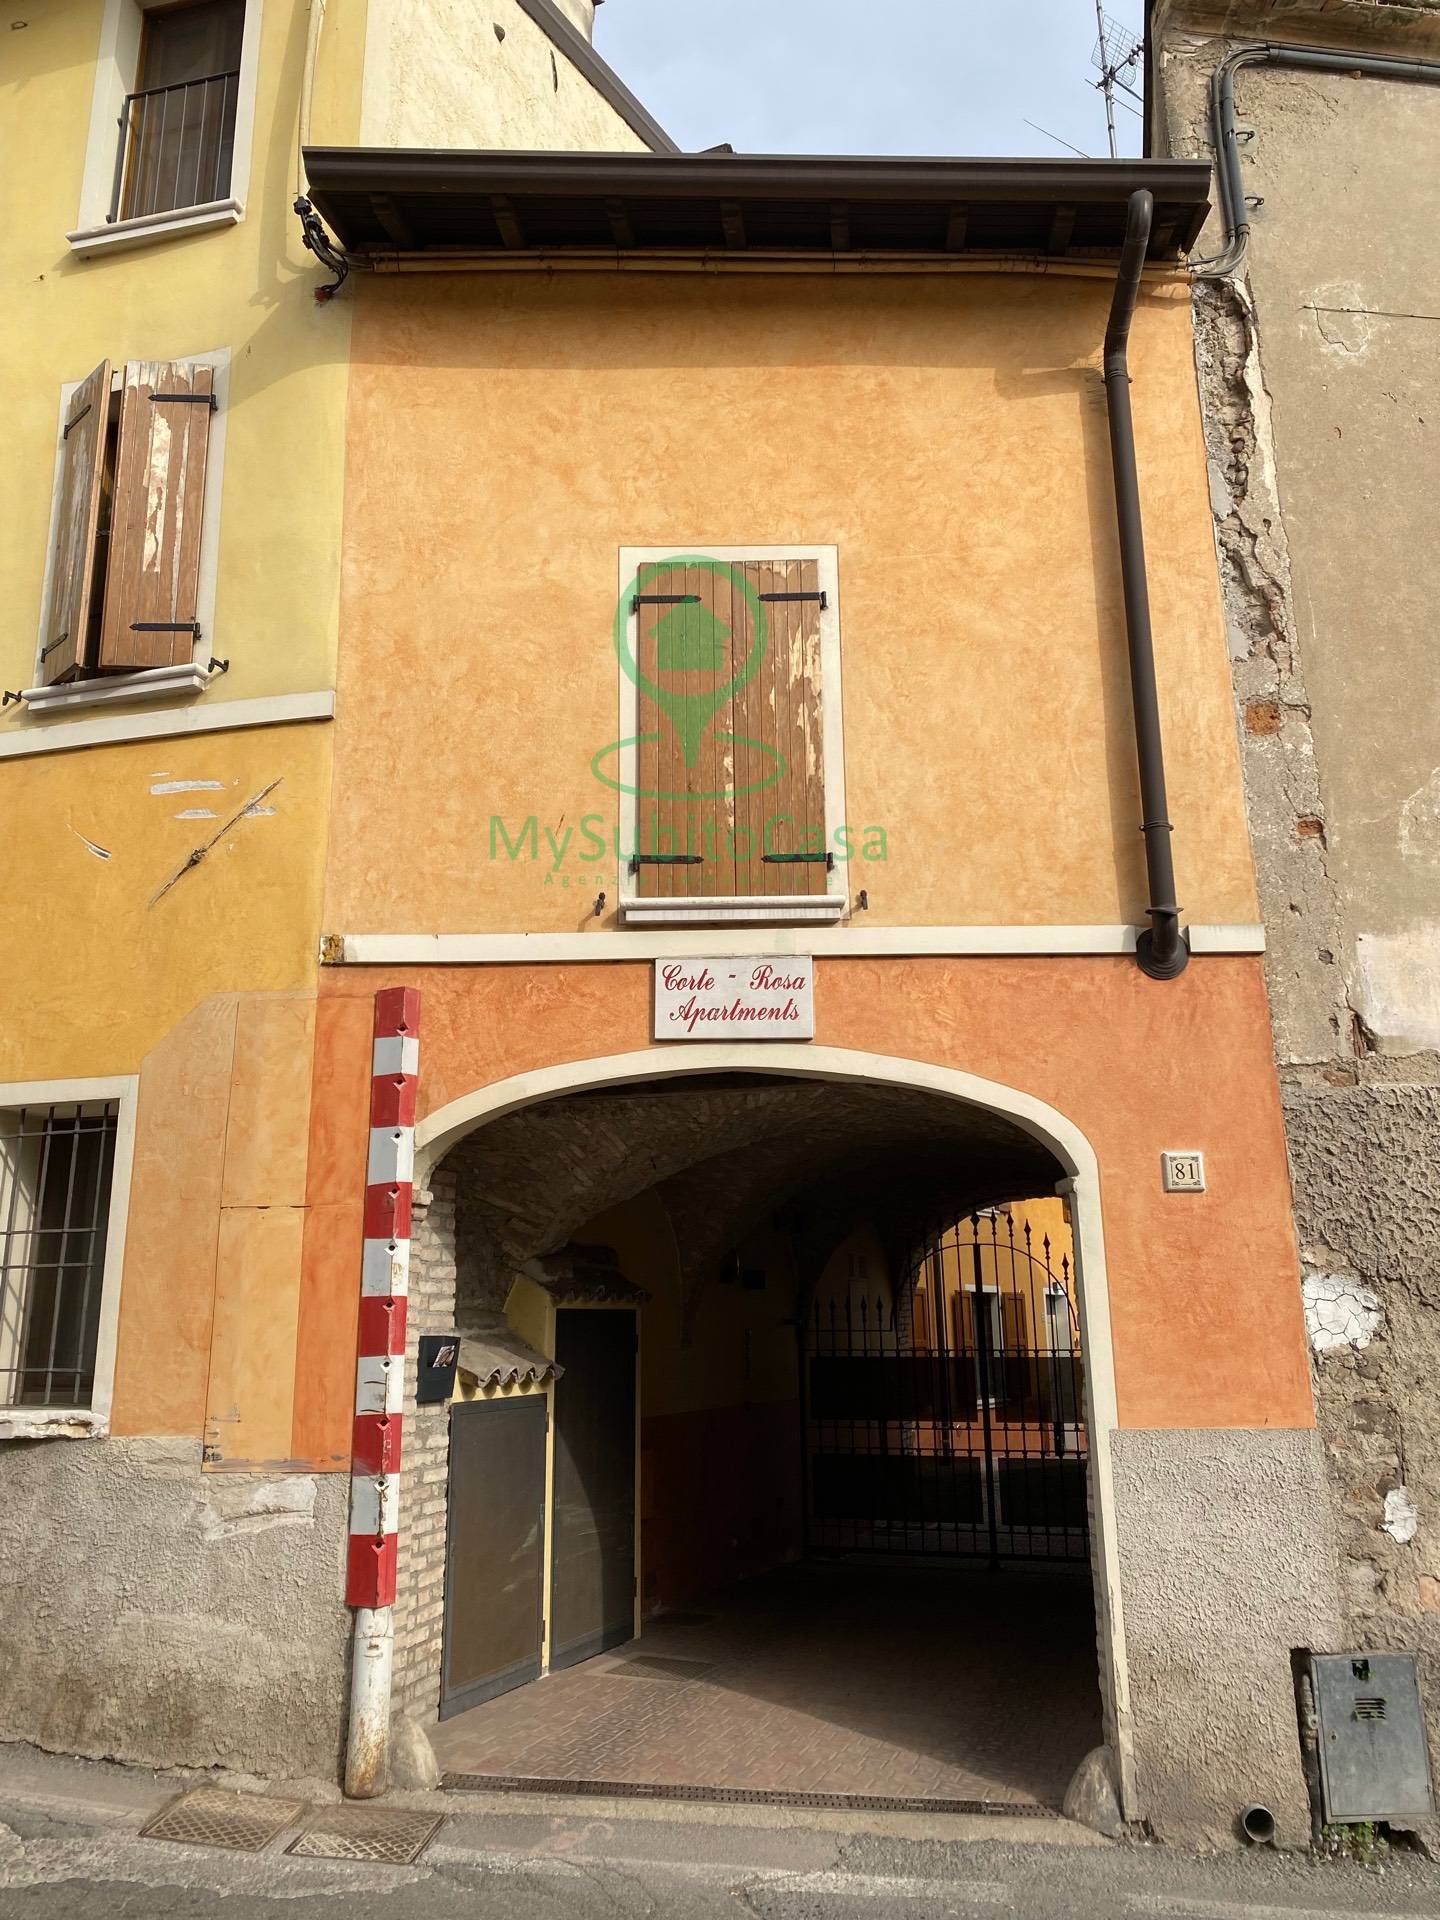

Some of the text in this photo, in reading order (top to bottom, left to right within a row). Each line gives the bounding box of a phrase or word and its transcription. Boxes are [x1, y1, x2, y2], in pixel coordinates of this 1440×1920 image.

[662, 964, 715, 990] Corte
[749, 964, 806, 990] Rosa
[669, 995, 800, 1033] Apartments
[1175, 1162, 1196, 1180] 81
